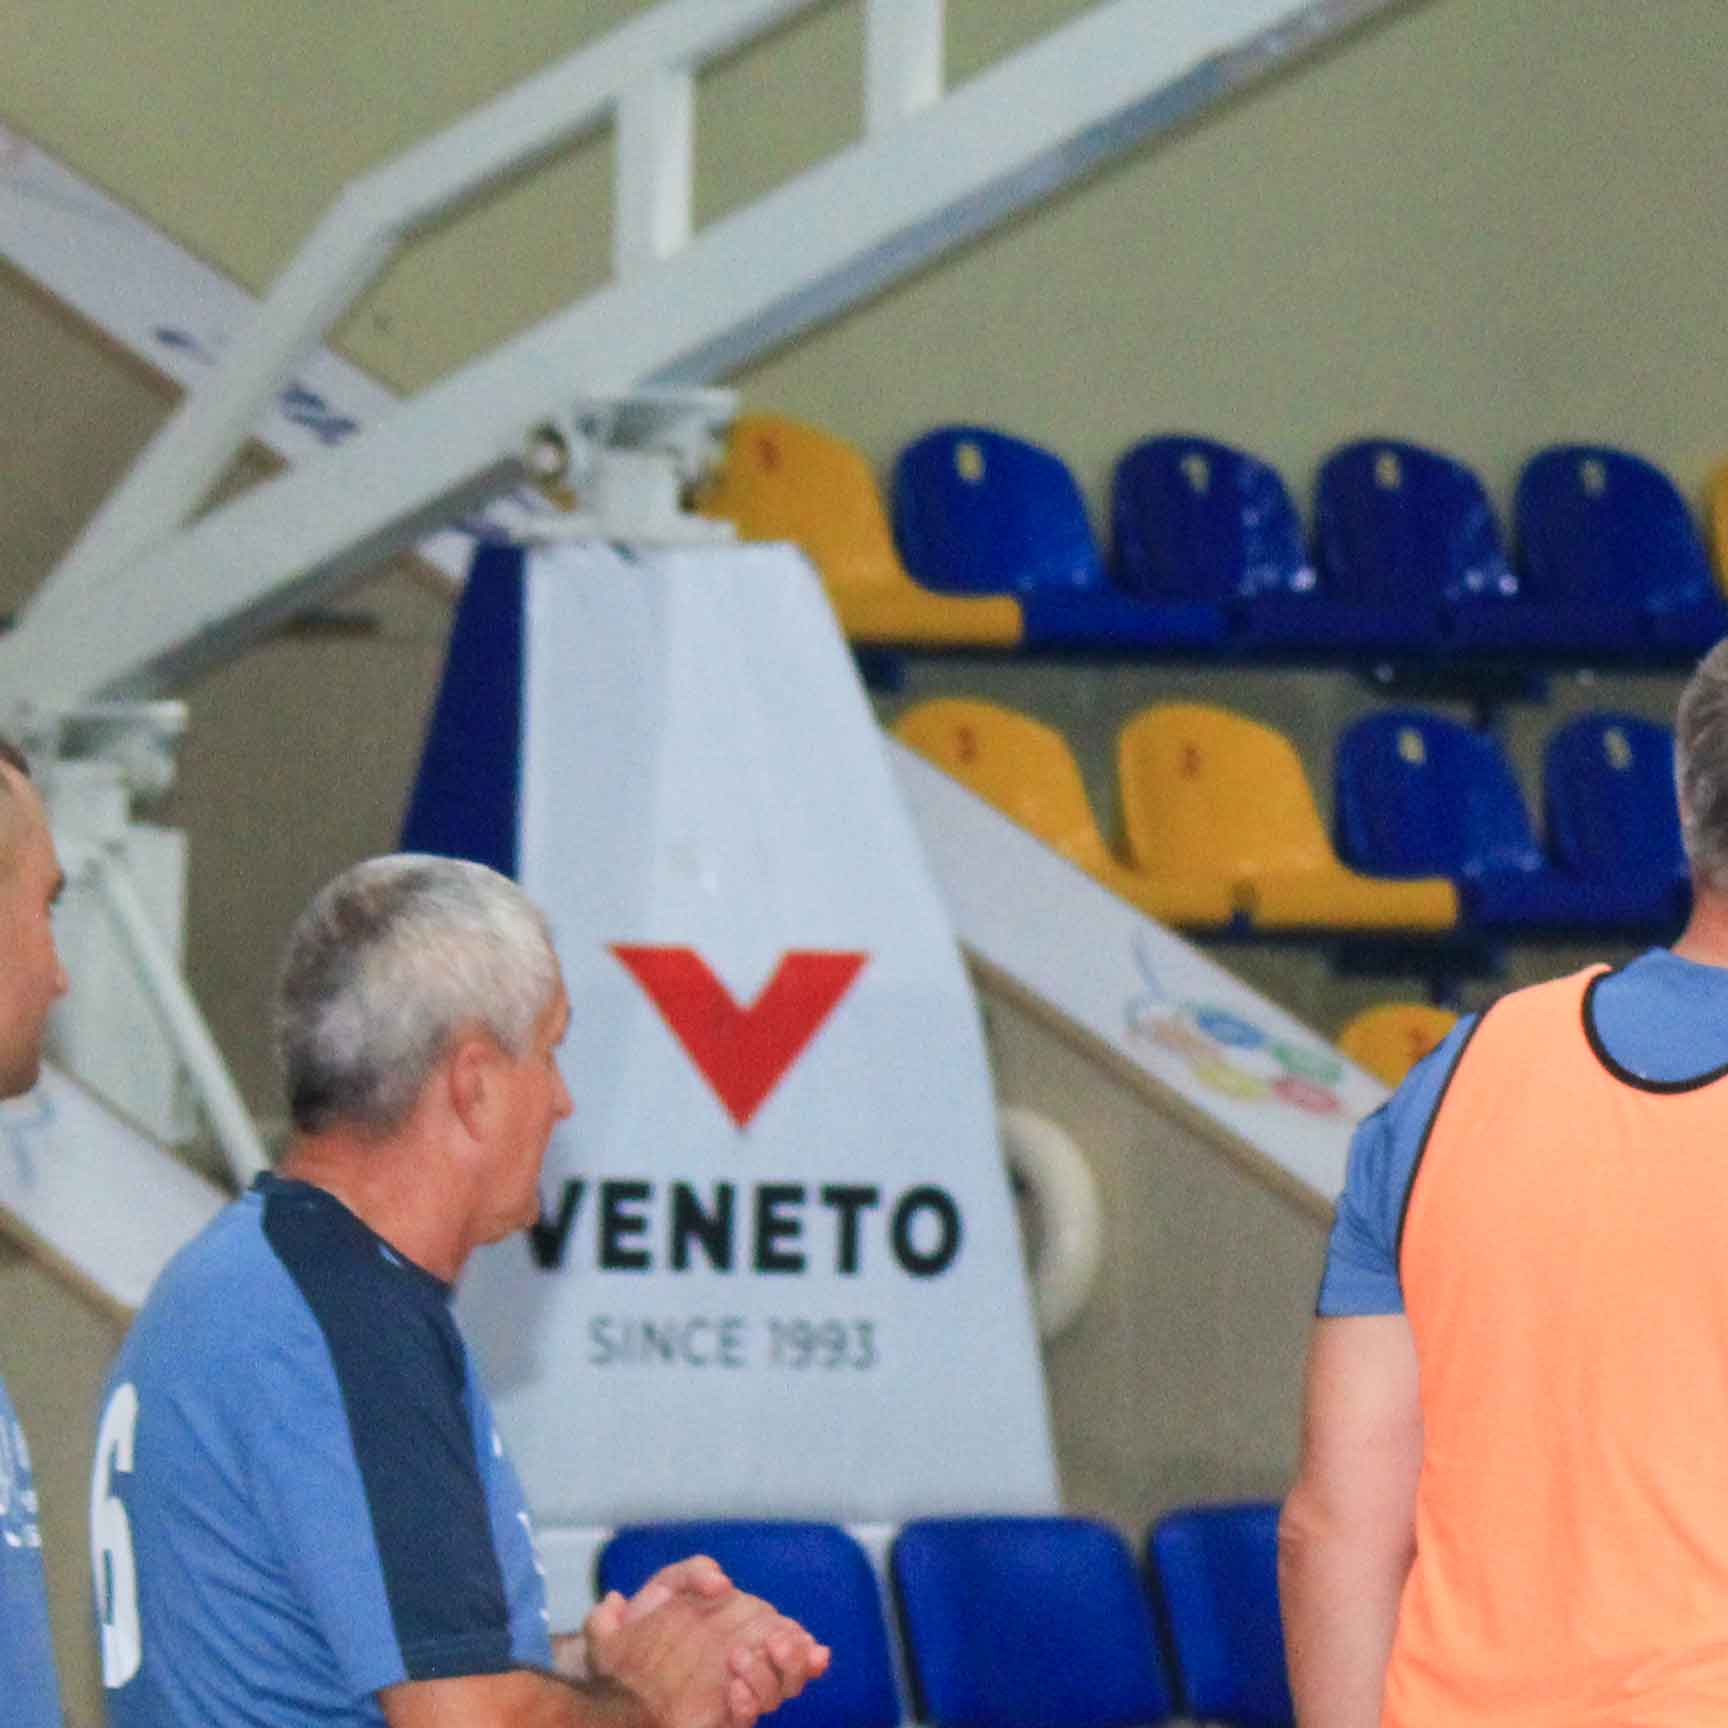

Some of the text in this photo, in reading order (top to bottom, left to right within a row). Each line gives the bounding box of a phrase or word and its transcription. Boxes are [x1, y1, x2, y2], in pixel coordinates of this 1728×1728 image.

[528, 1177, 963, 1279] VENETO
[588, 1314, 878, 1370] SINCE 1993
[91, 1382, 142, 1690] 6
